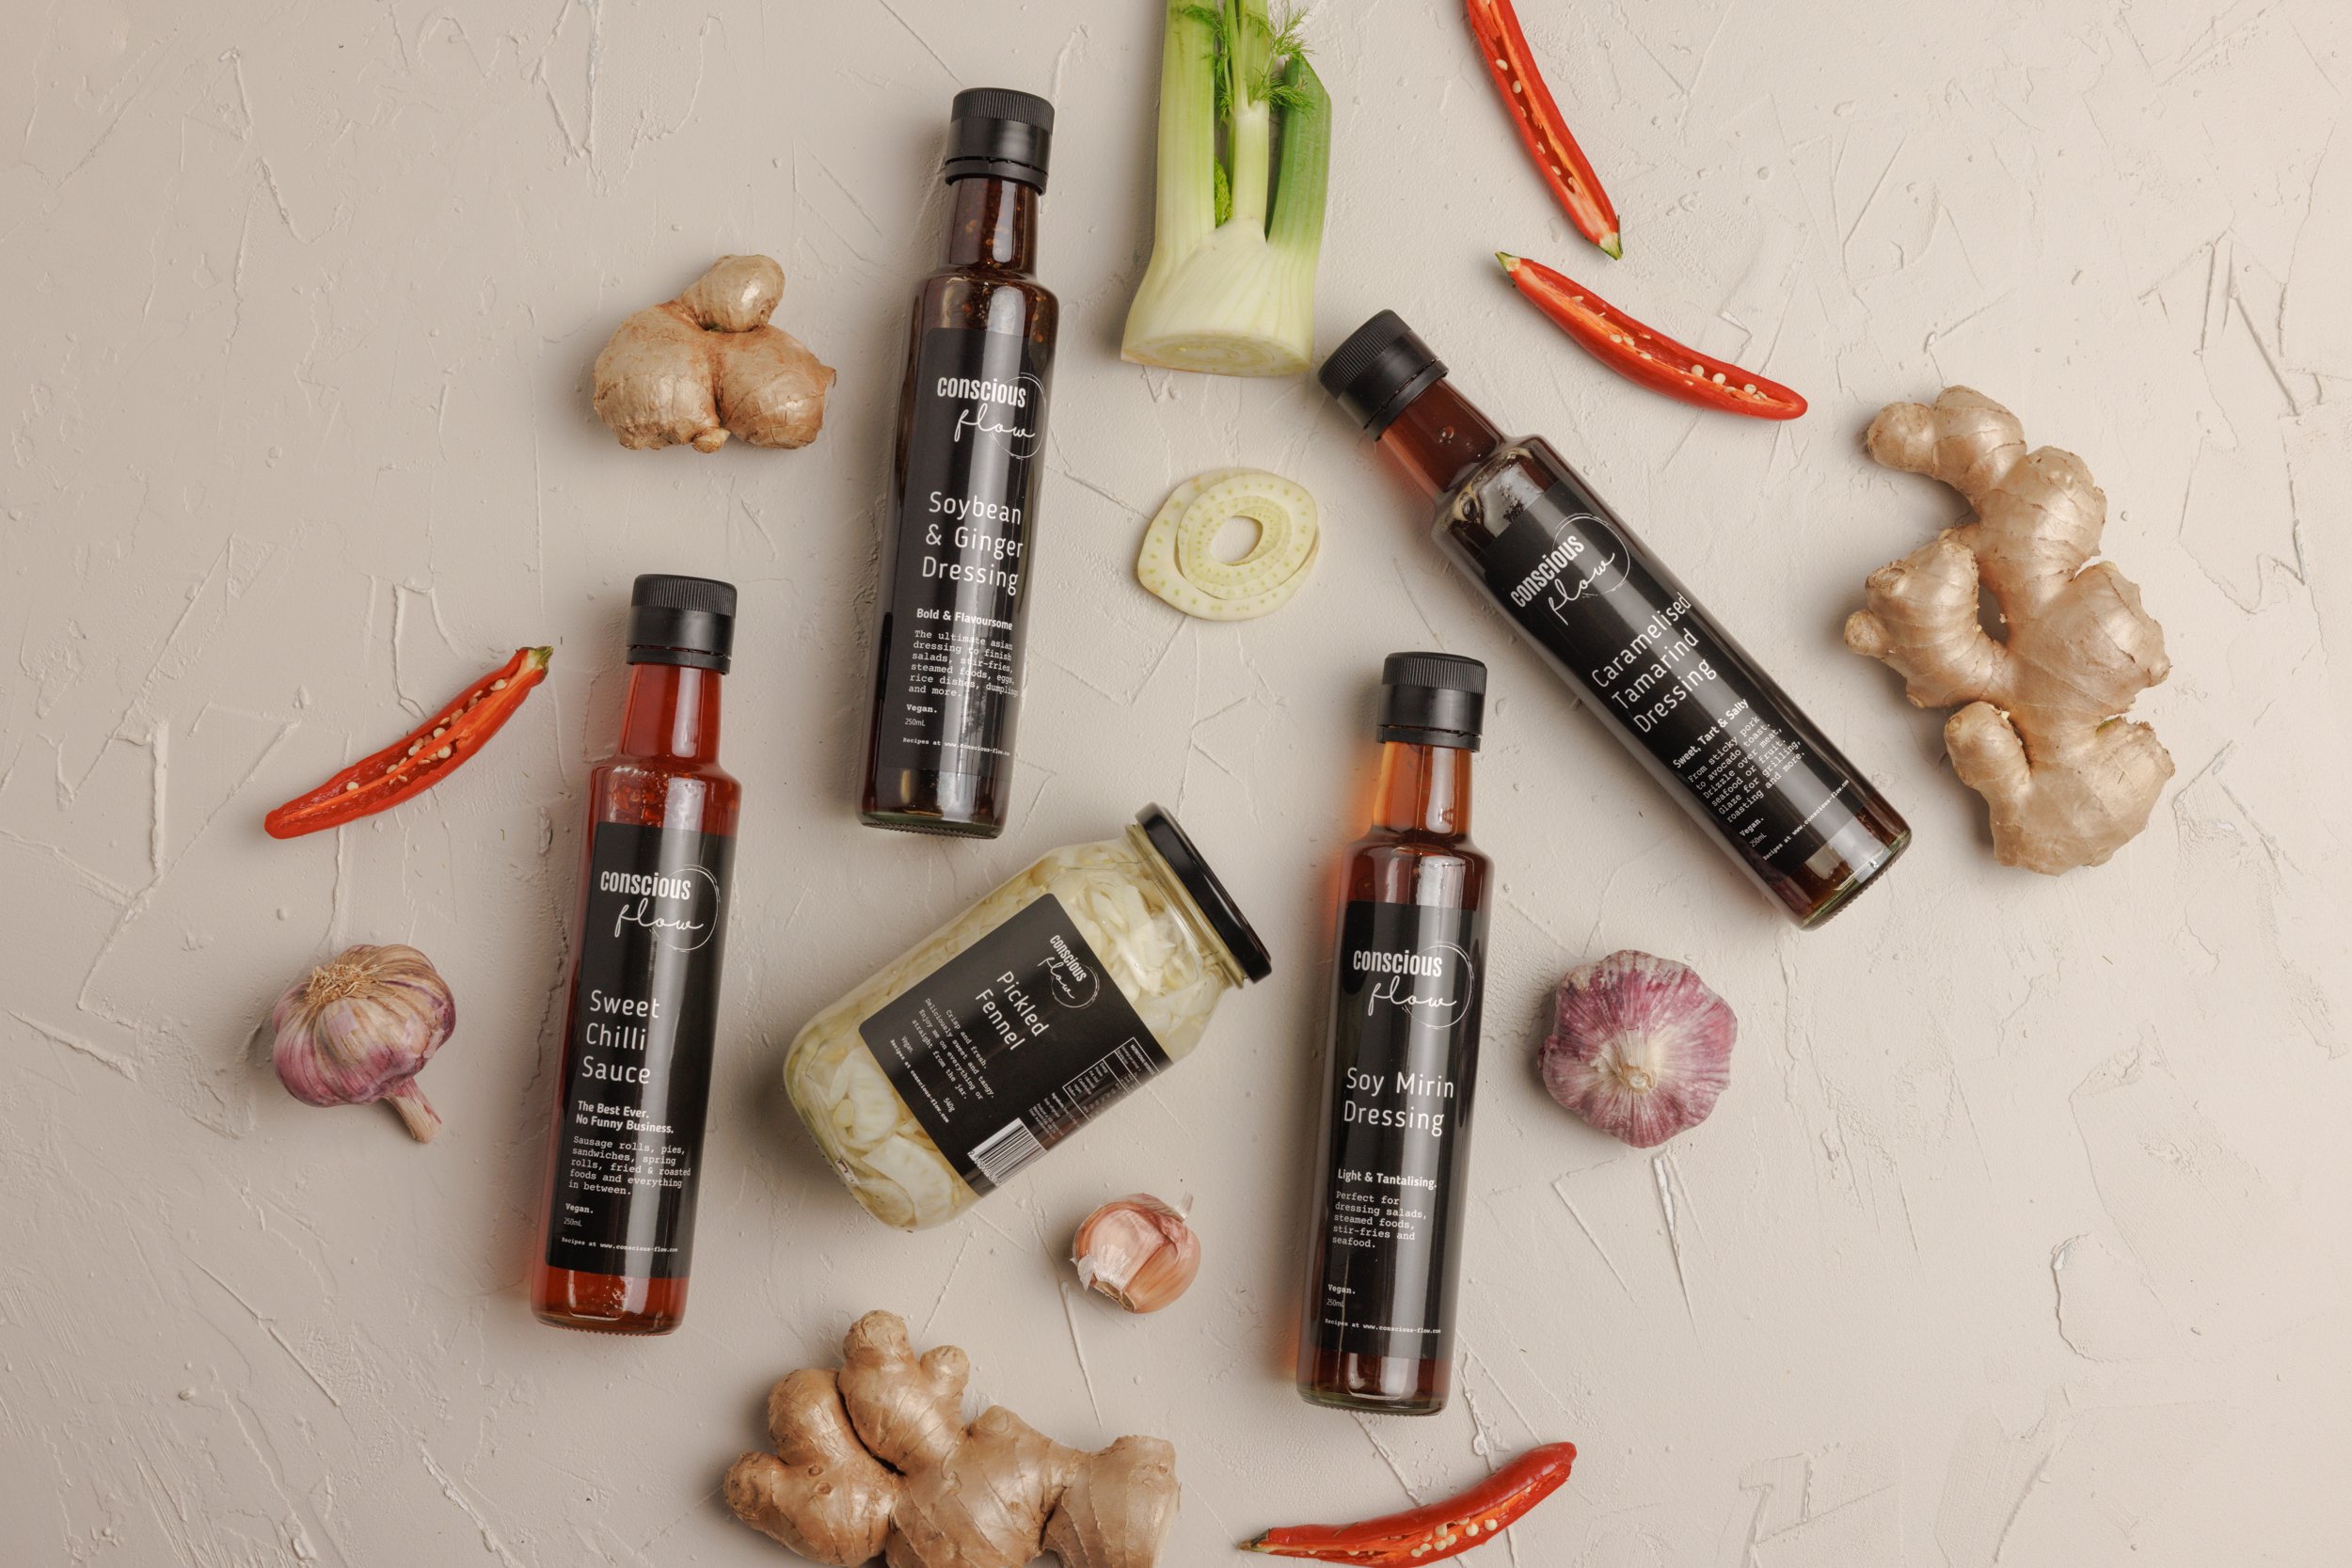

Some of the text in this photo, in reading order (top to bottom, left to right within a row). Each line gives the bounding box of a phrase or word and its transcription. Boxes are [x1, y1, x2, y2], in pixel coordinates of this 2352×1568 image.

[937, 377, 1026, 408] conscious
[954, 403, 1035, 442] flow
[929, 491, 1021, 525] Soybean
[926, 524, 1024, 561] & Ginger
[922, 556, 1018, 596] Dressing
[1510, 534, 1584, 608] conscious
[1549, 552, 1615, 626] flow
[916, 609, 1013, 630] Bold & Flavoursome
[914, 641, 961, 654] dressing
[984, 651, 1011, 661] finish
[938, 632, 986, 645] ultimate
[991, 640, 1013, 650] asian
[1591, 591, 1692, 688] Caramelised
[911, 663, 1015, 685] steamed foods, eggs,
[913, 652, 1013, 673] salads, stir-fries,
[1612, 628, 1699, 710] Tamarind
[908, 685, 961, 697] and more.
[910, 673, 933, 683] rice
[939, 676, 978, 689] dishes,
[907, 704, 937, 713] Vegan.
[1633, 659, 1717, 734] Dressing
[905, 718, 926, 726] 250mL
[1673, 698, 1749, 768] Sweet, Tart & Salty
[1687, 716, 1760, 784] From sticky pork
[1696, 722, 1771, 790] to avocado toast.
[1703, 728, 1783, 800] Drizzle over meat,
[1711, 739, 1786, 808] seafood or fruit.
[1718, 740, 1802, 815] Glaze for grilling,
[1726, 752, 1805, 823] roasting and more.
[1740, 817, 1764, 837] Vegan.
[1749, 832, 1767, 848] 250mL
[1763, 843, 1783, 861] Recipes
[1784, 834, 1792, 843] at
[600, 870, 691, 900] conscious
[614, 897, 704, 938] flow
[1050, 935, 1087, 982] conscious
[1353, 950, 1442, 977] conscious
[1037, 957, 1075, 999] flow
[590, 990, 660, 1018] Sweet
[996, 971, 1050, 1037] Pickled
[1368, 975, 1457, 1016] flow
[976, 989, 1025, 1051] Fennel
[586, 1022, 645, 1051] Chilli
[926, 998, 994, 1099] Deliciously sweet and tangy.
[946, 1009, 987, 1069] Crisp and fresh.
[912, 1020, 967, 1100] straight from the jar.
[919, 1009, 984, 1100] Enjoy me on everything or
[581, 1055, 650, 1085] Sauce
[890, 1038, 905, 1060] Recipes
[911, 1070, 949, 1123] conscious-flow.com
[1346, 1067, 1454, 1099] Soy Mirin
[578, 1101, 649, 1118] The Best Ever.
[944, 1097, 955, 1113] 540g
[1344, 1100, 1444, 1137] Dressing
[576, 1114, 674, 1133] No Funny Business.
[572, 1148, 676, 1166] sandwiches, spring
[574, 1135, 685, 1155] Sausage rolls, pies,
[570, 1159, 691, 1176] rolls, fried & roasted
[570, 1169, 682, 1189] foods and everything
[1338, 1168, 1438, 1190] Light & Tantalising.
[568, 1180, 631, 1195] in between.
[1336, 1191, 1400, 1205] Perfect for
[565, 1203, 594, 1213] Vegan.
[1334, 1213, 1415, 1230] steamed foods,
[1335, 1202, 1427, 1219] dressing salads,
[562, 1237, 585, 1245] Recipes
[600, 1242, 677, 1253] www.conscious-flow.com
[1332, 1236, 1375, 1248] seafood.
[1333, 1225, 1415, 1241] stir-fries and
[1327, 1284, 1356, 1294] Vegan.
[1325, 1318, 1348, 1327] Recipes
[1363, 1323, 1441, 1334] www.conscious-flow.com
